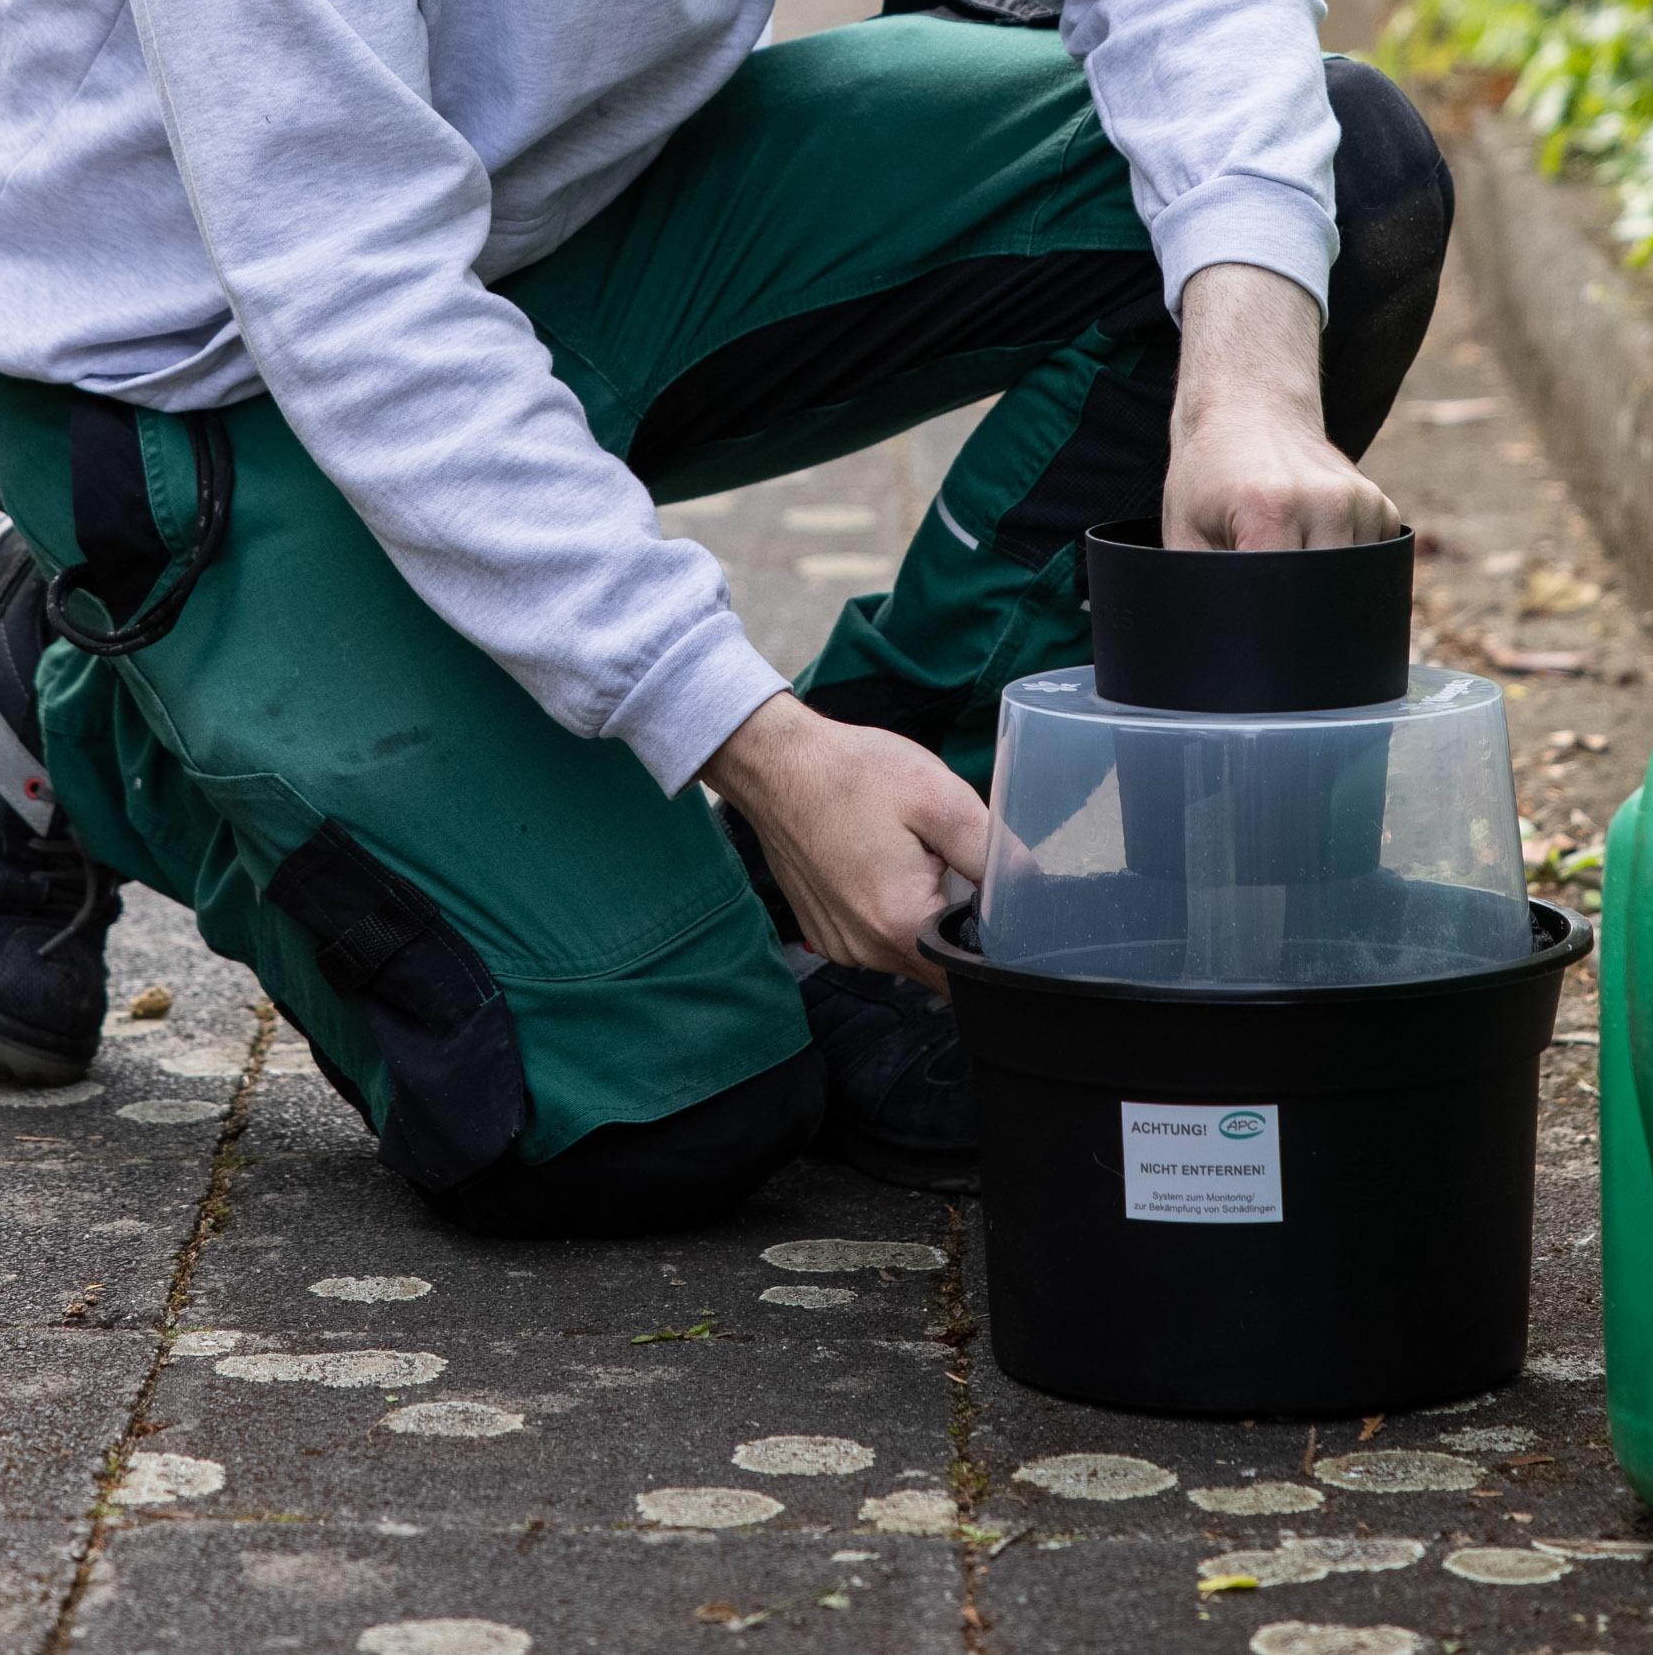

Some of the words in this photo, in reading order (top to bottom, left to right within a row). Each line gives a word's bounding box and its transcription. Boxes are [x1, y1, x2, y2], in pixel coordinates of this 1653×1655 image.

[1131, 1121, 1207, 1136] ACHTUNG!
[1226, 1119, 1258, 1131] APC
[1140, 1162, 1178, 1175] NICHT
[1182, 1164, 1265, 1176] ENTFERNEN!
[1152, 1191, 1184, 1202] System
[1186, 1194, 1205, 1202] zum
[1149, 1203, 1202, 1214] Bekämpfung
[1204, 1205, 1220, 1213] von
[1222, 1204, 1276, 1215] Schädlingen
